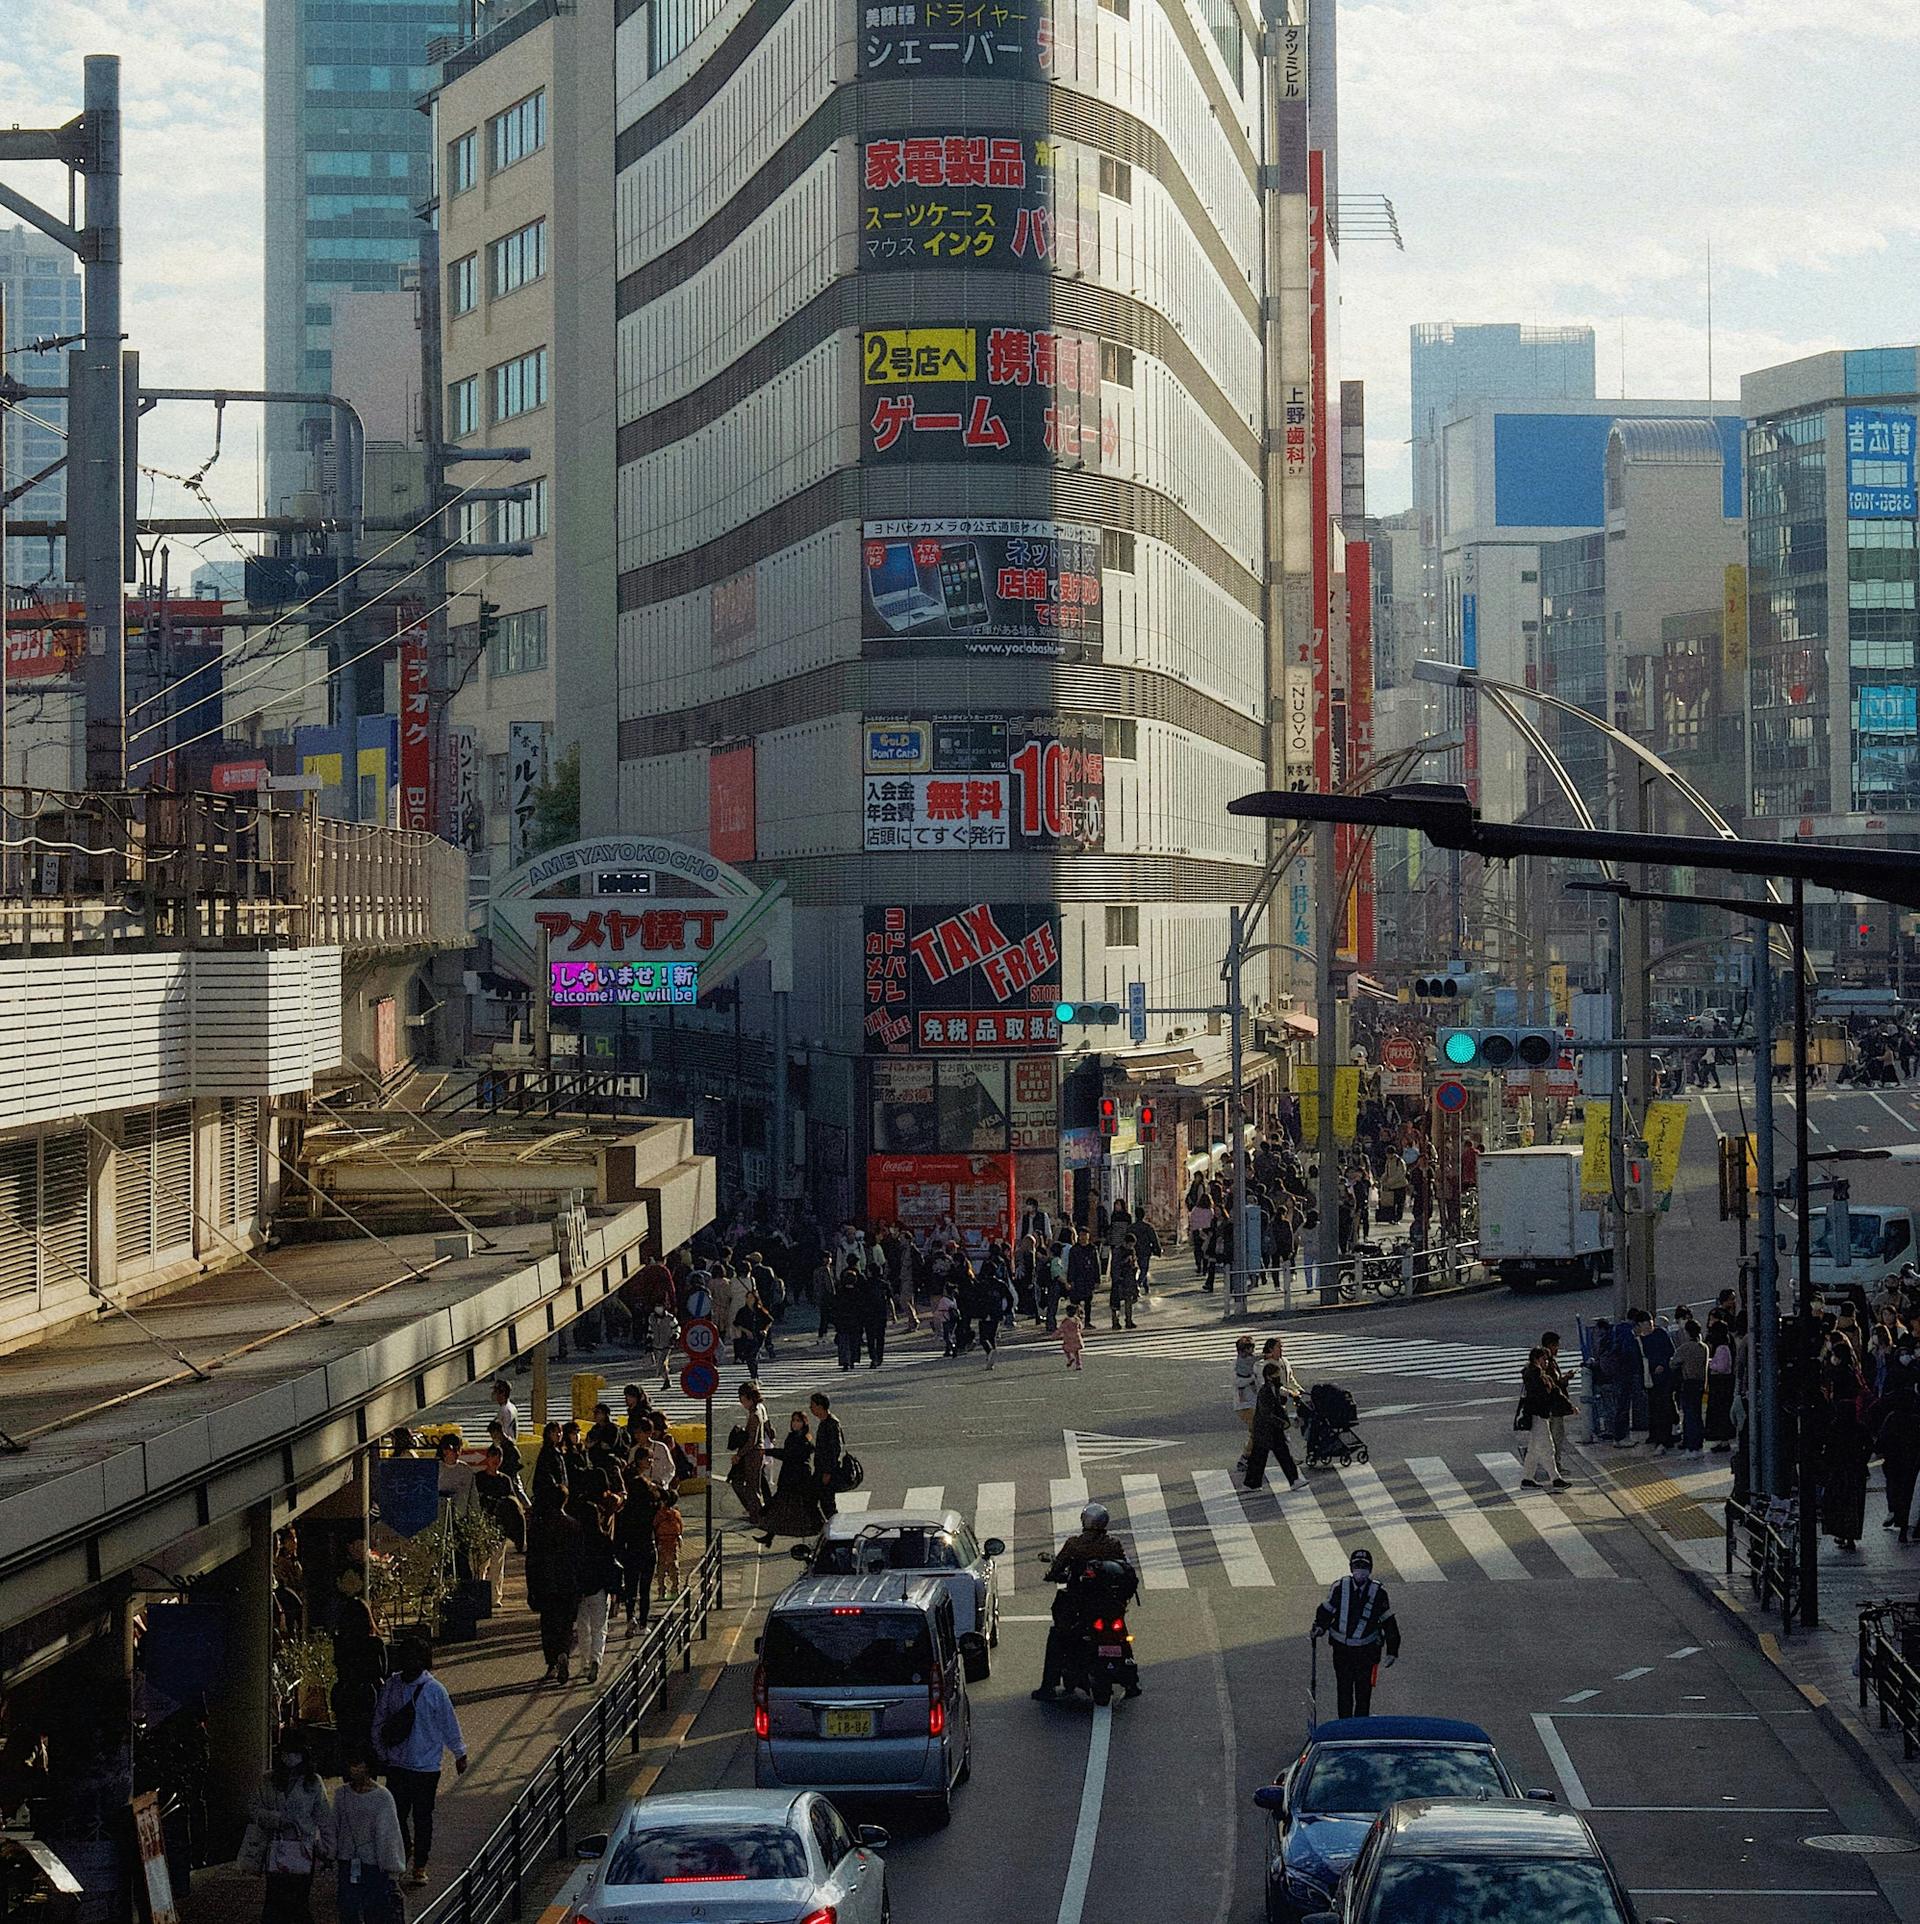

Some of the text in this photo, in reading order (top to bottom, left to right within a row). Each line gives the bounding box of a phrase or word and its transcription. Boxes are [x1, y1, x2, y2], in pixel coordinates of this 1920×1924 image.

[924, 1, 1029, 27] ドライヤー
[866, 31, 1023, 68] シェーバー
[1285, 29, 1300, 97] タツミビル
[865, 136, 1026, 190] 家電製品
[865, 202, 996, 230] スーツケース
[866, 231, 996, 258] マウス インク
[867, 335, 969, 380] 2号店へ
[870, 395, 1010, 452] ゲーム
[1286, 387, 1305, 464] 上野歯科
[874, 520, 1048, 535] ヨドバシカメラの公式通販サイト
[1292, 687, 1306, 749] NUOVO
[866, 781, 915, 801] 入会金
[926, 780, 1003, 820] 無料
[866, 803, 915, 823] 年会費
[866, 826, 1006, 846] 店頭にてすぐ発行
[528, 842, 720, 887] AMEYAYOKOCHO
[535, 910, 728, 951] アメヤ横丁
[911, 903, 1011, 985] TAX
[866, 932, 884, 1003] カメラ
[885, 908, 907, 1002] ヨドバシ
[980, 921, 1059, 1003] FREE
[618, 990, 641, 1002] We
[644, 989, 671, 1002] will
[675, 989, 692, 1002] be
[1030, 984, 1060, 1003] STORE
[864, 1006, 892, 1036] TAX
[880, 1015, 912, 1046] FREE
[977, 1112, 1002, 1130] VISA
[882, 1160, 913, 1172] Coca-Cola
[689, 1330, 710, 1347] 30
